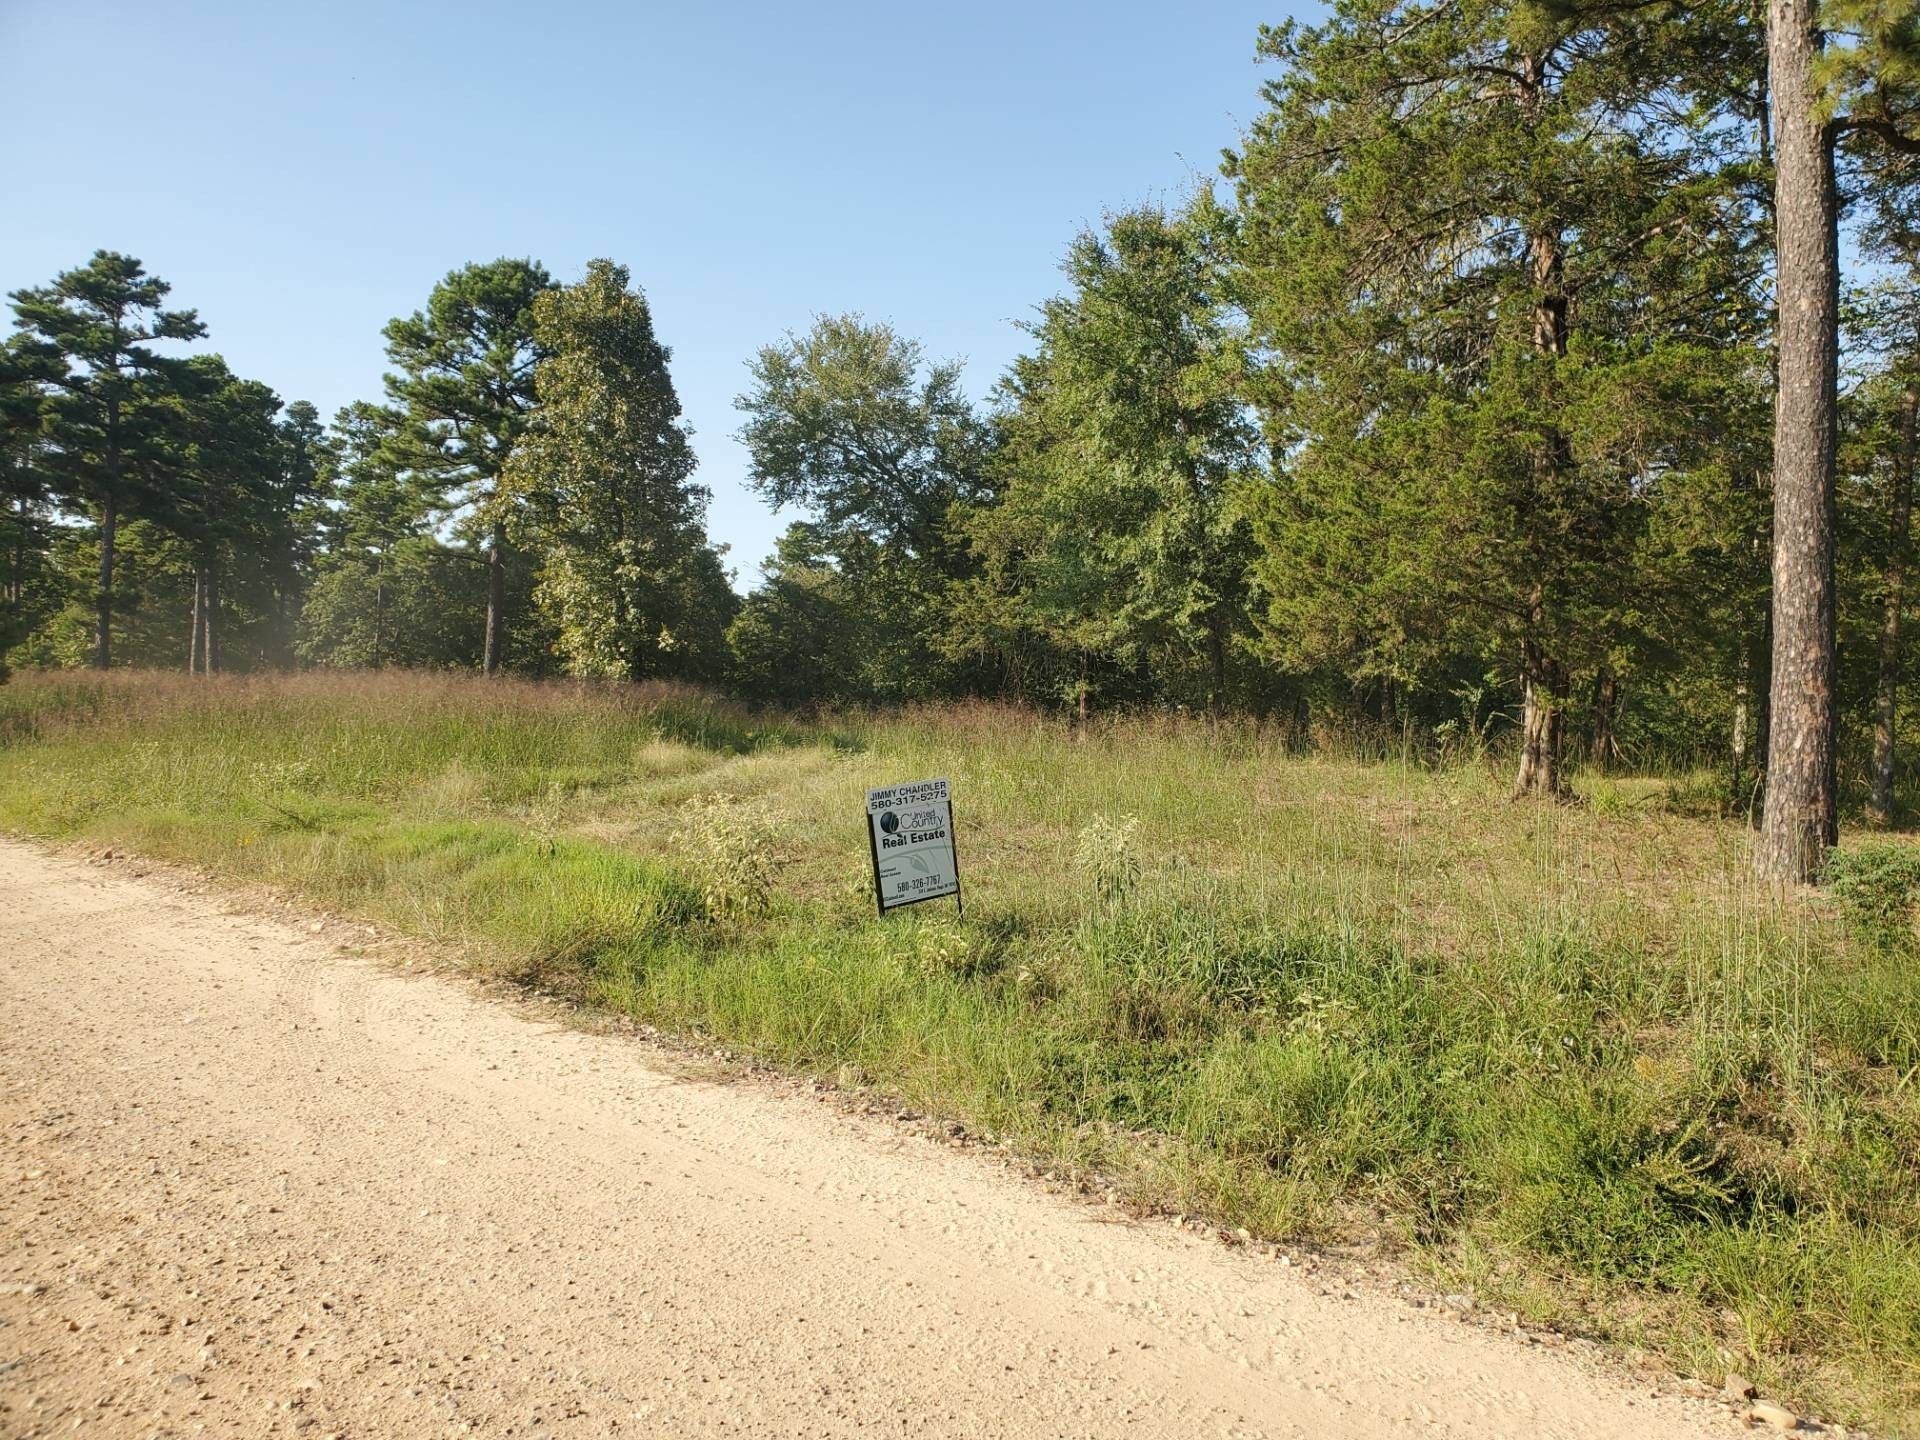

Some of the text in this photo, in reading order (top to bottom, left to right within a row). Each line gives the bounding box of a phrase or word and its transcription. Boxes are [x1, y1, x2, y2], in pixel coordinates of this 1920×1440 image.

[870, 781, 946, 801] JIMMY CHANDLER
[871, 790, 947, 810] 580-317-5275
[901, 815, 943, 829] Country
[882, 830, 946, 849] Real Estate
